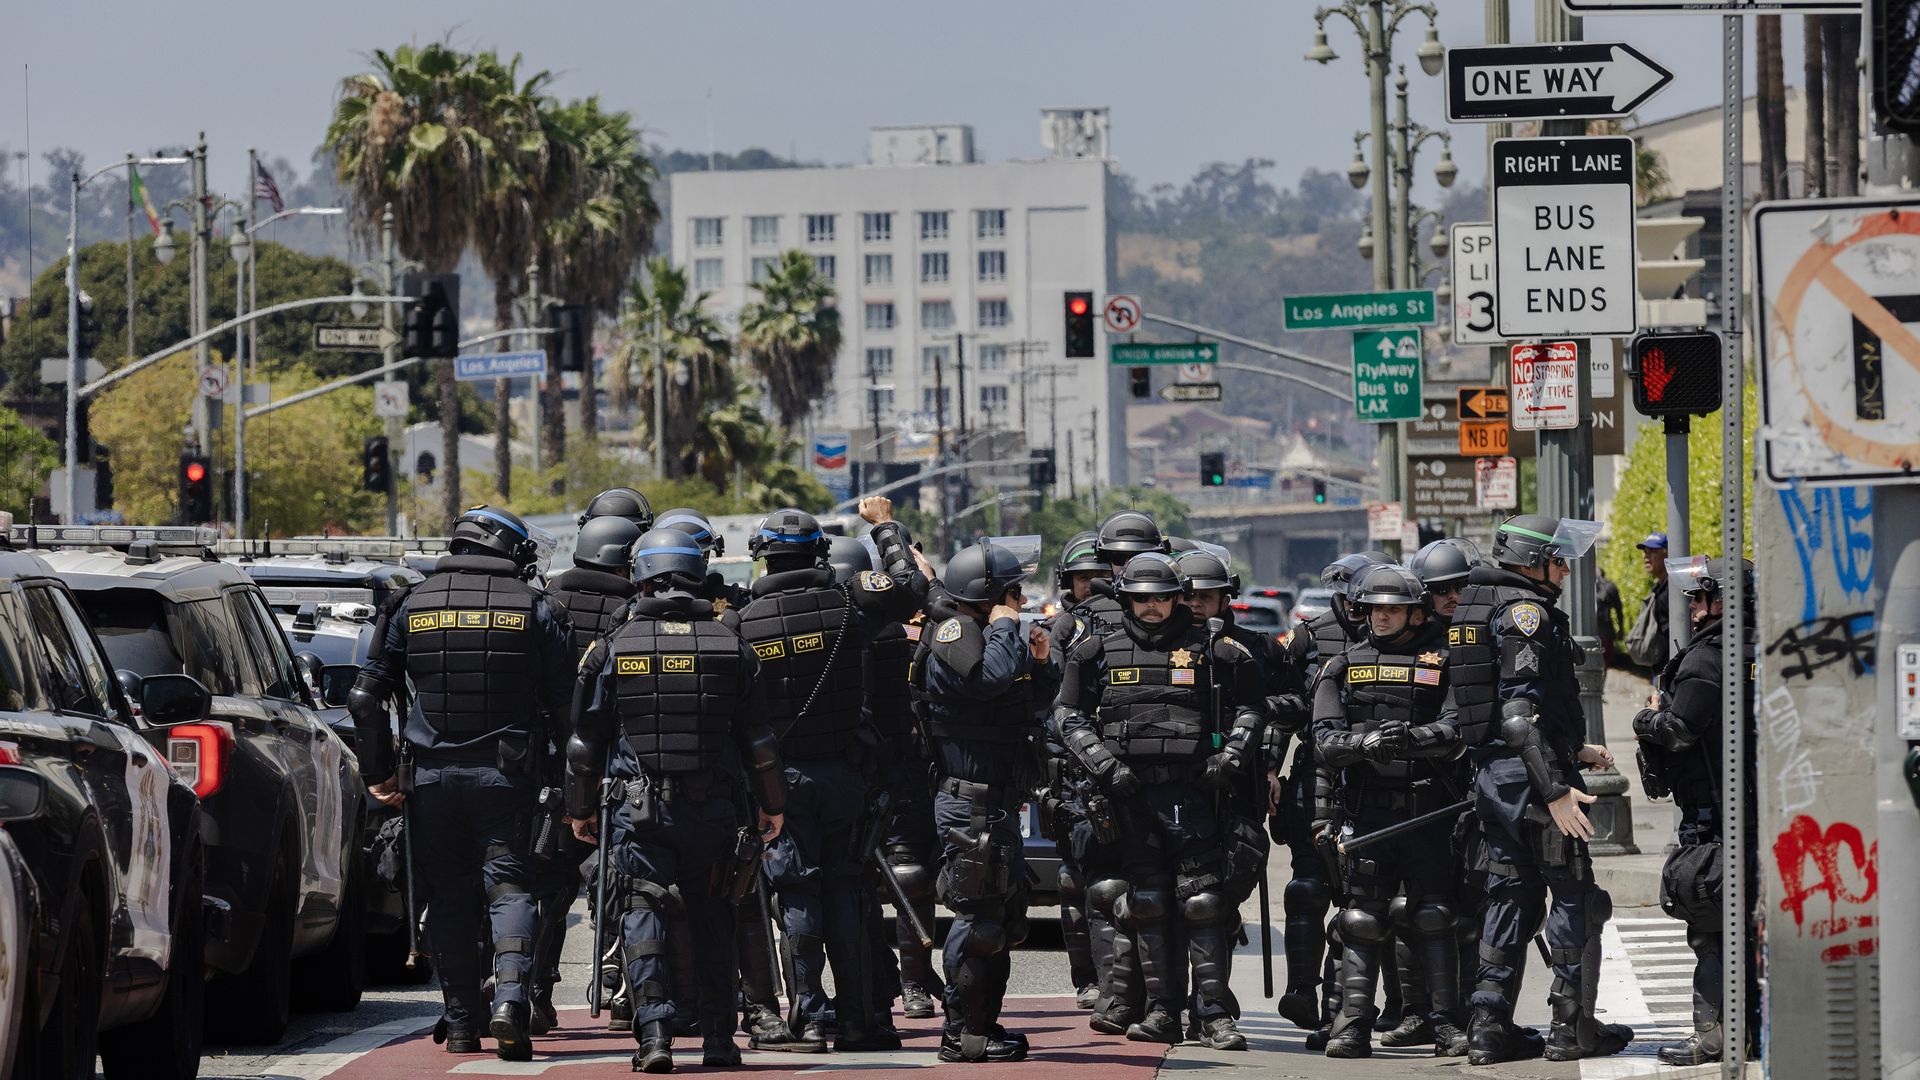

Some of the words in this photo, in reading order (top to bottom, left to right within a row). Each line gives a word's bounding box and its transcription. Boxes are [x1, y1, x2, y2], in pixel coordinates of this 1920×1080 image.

[1472, 69, 1532, 97] ONE
[1543, 66, 1604, 93] WAY
[1504, 156, 1561, 173] RIGHT
[1571, 154, 1622, 172] LANE
[1535, 205, 1595, 231] BUS
[1461, 236, 1492, 254] SP
[1526, 245, 1605, 271] LANE
[1470, 263, 1489, 281] LI
[1527, 287, 1607, 313] ENDS
[1292, 306, 1323, 321] Los
[1331, 302, 1398, 321] Angeles
[1406, 300, 1425, 315] St
[1466, 291, 1495, 332] 3
[324, 330, 348, 343] ONE
[358, 330, 379, 342] WAY
[1116, 348, 1149, 359] UNION
[461, 359, 485, 373] Los
[491, 356, 540, 372] Angeles
[1357, 362, 1415, 380] FlyAway
[1514, 361, 1533, 384] NO
[1535, 363, 1574, 380] STOPPING
[1592, 362, 1609, 371] tro
[1358, 382, 1386, 397] Bus
[1393, 381, 1408, 395] to
[1517, 386, 1542, 400] ANY
[1547, 385, 1574, 398] TIME
[1359, 400, 1388, 414] LAX
[1485, 397, 1504, 410] DE
[1415, 421, 1438, 432] Short
[1469, 429, 1488, 448] NB
[1493, 429, 1508, 448] 10
[1415, 478, 1440, 488] Union
[1443, 478, 1473, 488] Station
[413, 617, 435, 628] COA
[442, 614, 453, 623] LB
[497, 616, 521, 626] CHP
[757, 645, 781, 657] COA
[797, 637, 819, 649] CHP
[622, 661, 646, 670] COA
[666, 659, 691, 669] CHP
[1351, 668, 1373, 680] COA
[1382, 668, 1406, 679] CHP
